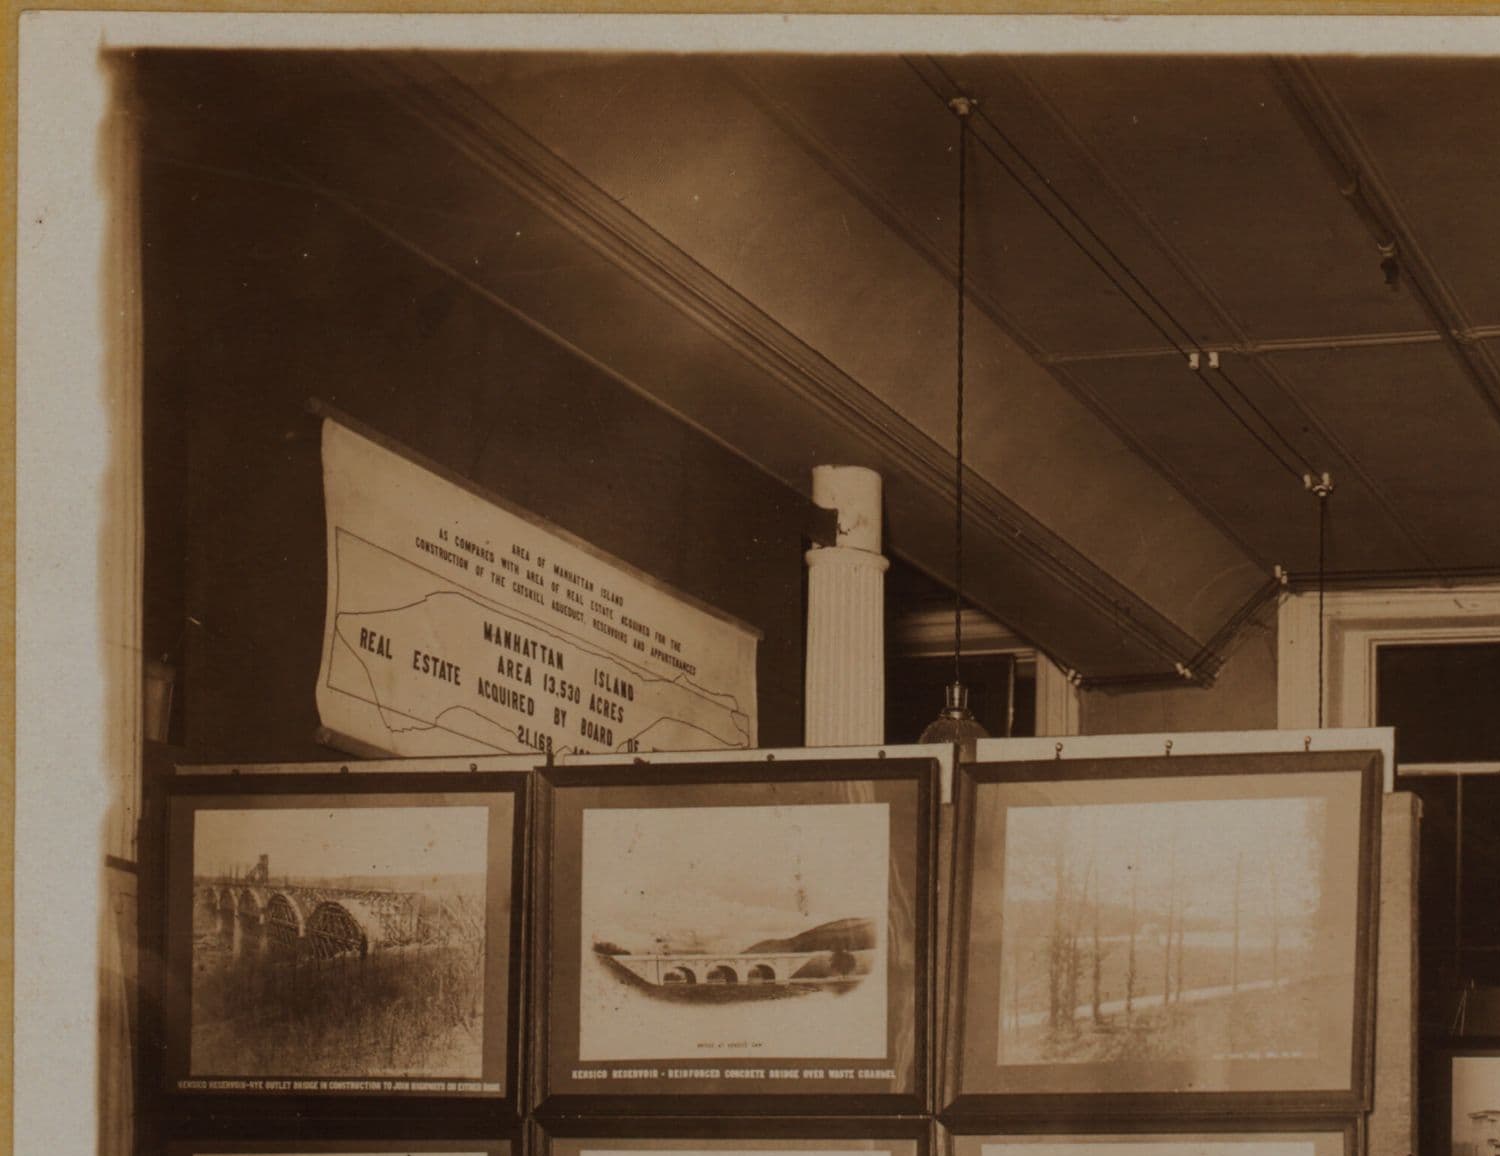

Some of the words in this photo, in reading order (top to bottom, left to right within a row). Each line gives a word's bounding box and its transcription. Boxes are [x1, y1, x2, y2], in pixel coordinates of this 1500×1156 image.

[415, 537, 469, 570] CONSTRUCTION
[475, 564, 485, 576] OF
[491, 571, 506, 587] THE
[513, 581, 545, 606] CATSKILL
[593, 618, 628, 644] RESERVOIRS
[634, 638, 646, 652] AND
[650, 647, 697, 676] APPURTENANCES
[438, 528, 448, 542] AS
[454, 534, 494, 564] COMPARED
[501, 557, 520, 575] WITH
[526, 568, 544, 587] AREA
[551, 580, 561, 593] OF
[566, 586, 584, 606] REAL
[591, 598, 614, 620] ESTATE
[621, 612, 651, 637] ACQUIRED
[655, 630, 667, 644] FOR
[670, 637, 682, 653] THE
[512, 544, 530, 562] AREA
[536, 556, 546, 569] OF
[554, 564, 594, 591] MANHATTAN
[601, 584, 624, 607] ISLAND
[359, 626, 394, 660] REAL
[412, 649, 462, 687] ESTATE
[477, 677, 535, 717] ACQUIRED
[553, 706, 568, 729] BY
[580, 717, 614, 747] BOARD
[627, 738, 640, 753] OF
[483, 620, 565, 671] MANHATTAN
[594, 668, 635, 702] ISLAND
[497, 655, 533, 686] AREA
[589, 693, 625, 724] ACRES
[320, 1081, 328, 1091] IN
[383, 1081, 393, 1091] TO
[572, 1069, 608, 1080] KENSICO
[612, 1069, 659, 1080] RESERVOIR
[803, 1069, 825, 1080] OVER
